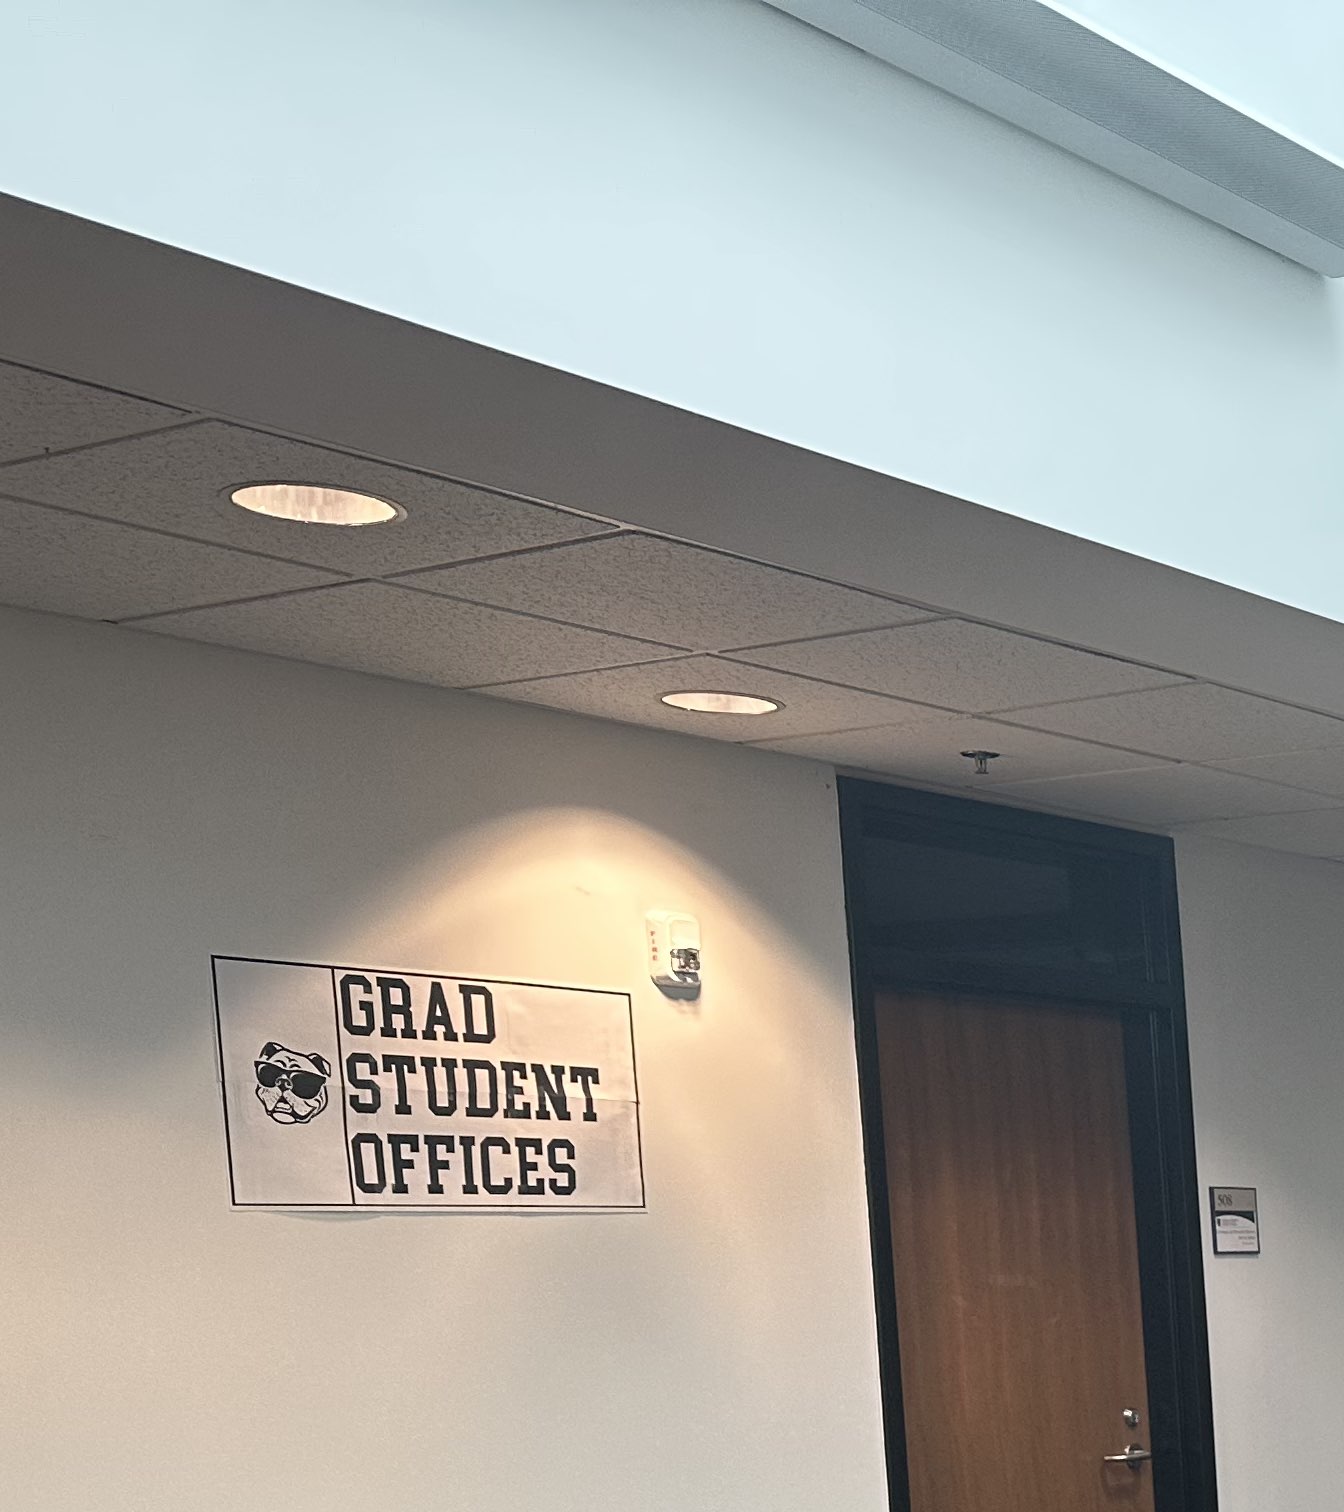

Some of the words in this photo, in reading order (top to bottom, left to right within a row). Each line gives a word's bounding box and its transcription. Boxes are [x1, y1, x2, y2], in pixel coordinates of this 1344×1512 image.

[340, 974, 497, 1044] GRAD
[346, 1053, 601, 1122] STUDENT
[351, 1132, 578, 1197] OFFICES
